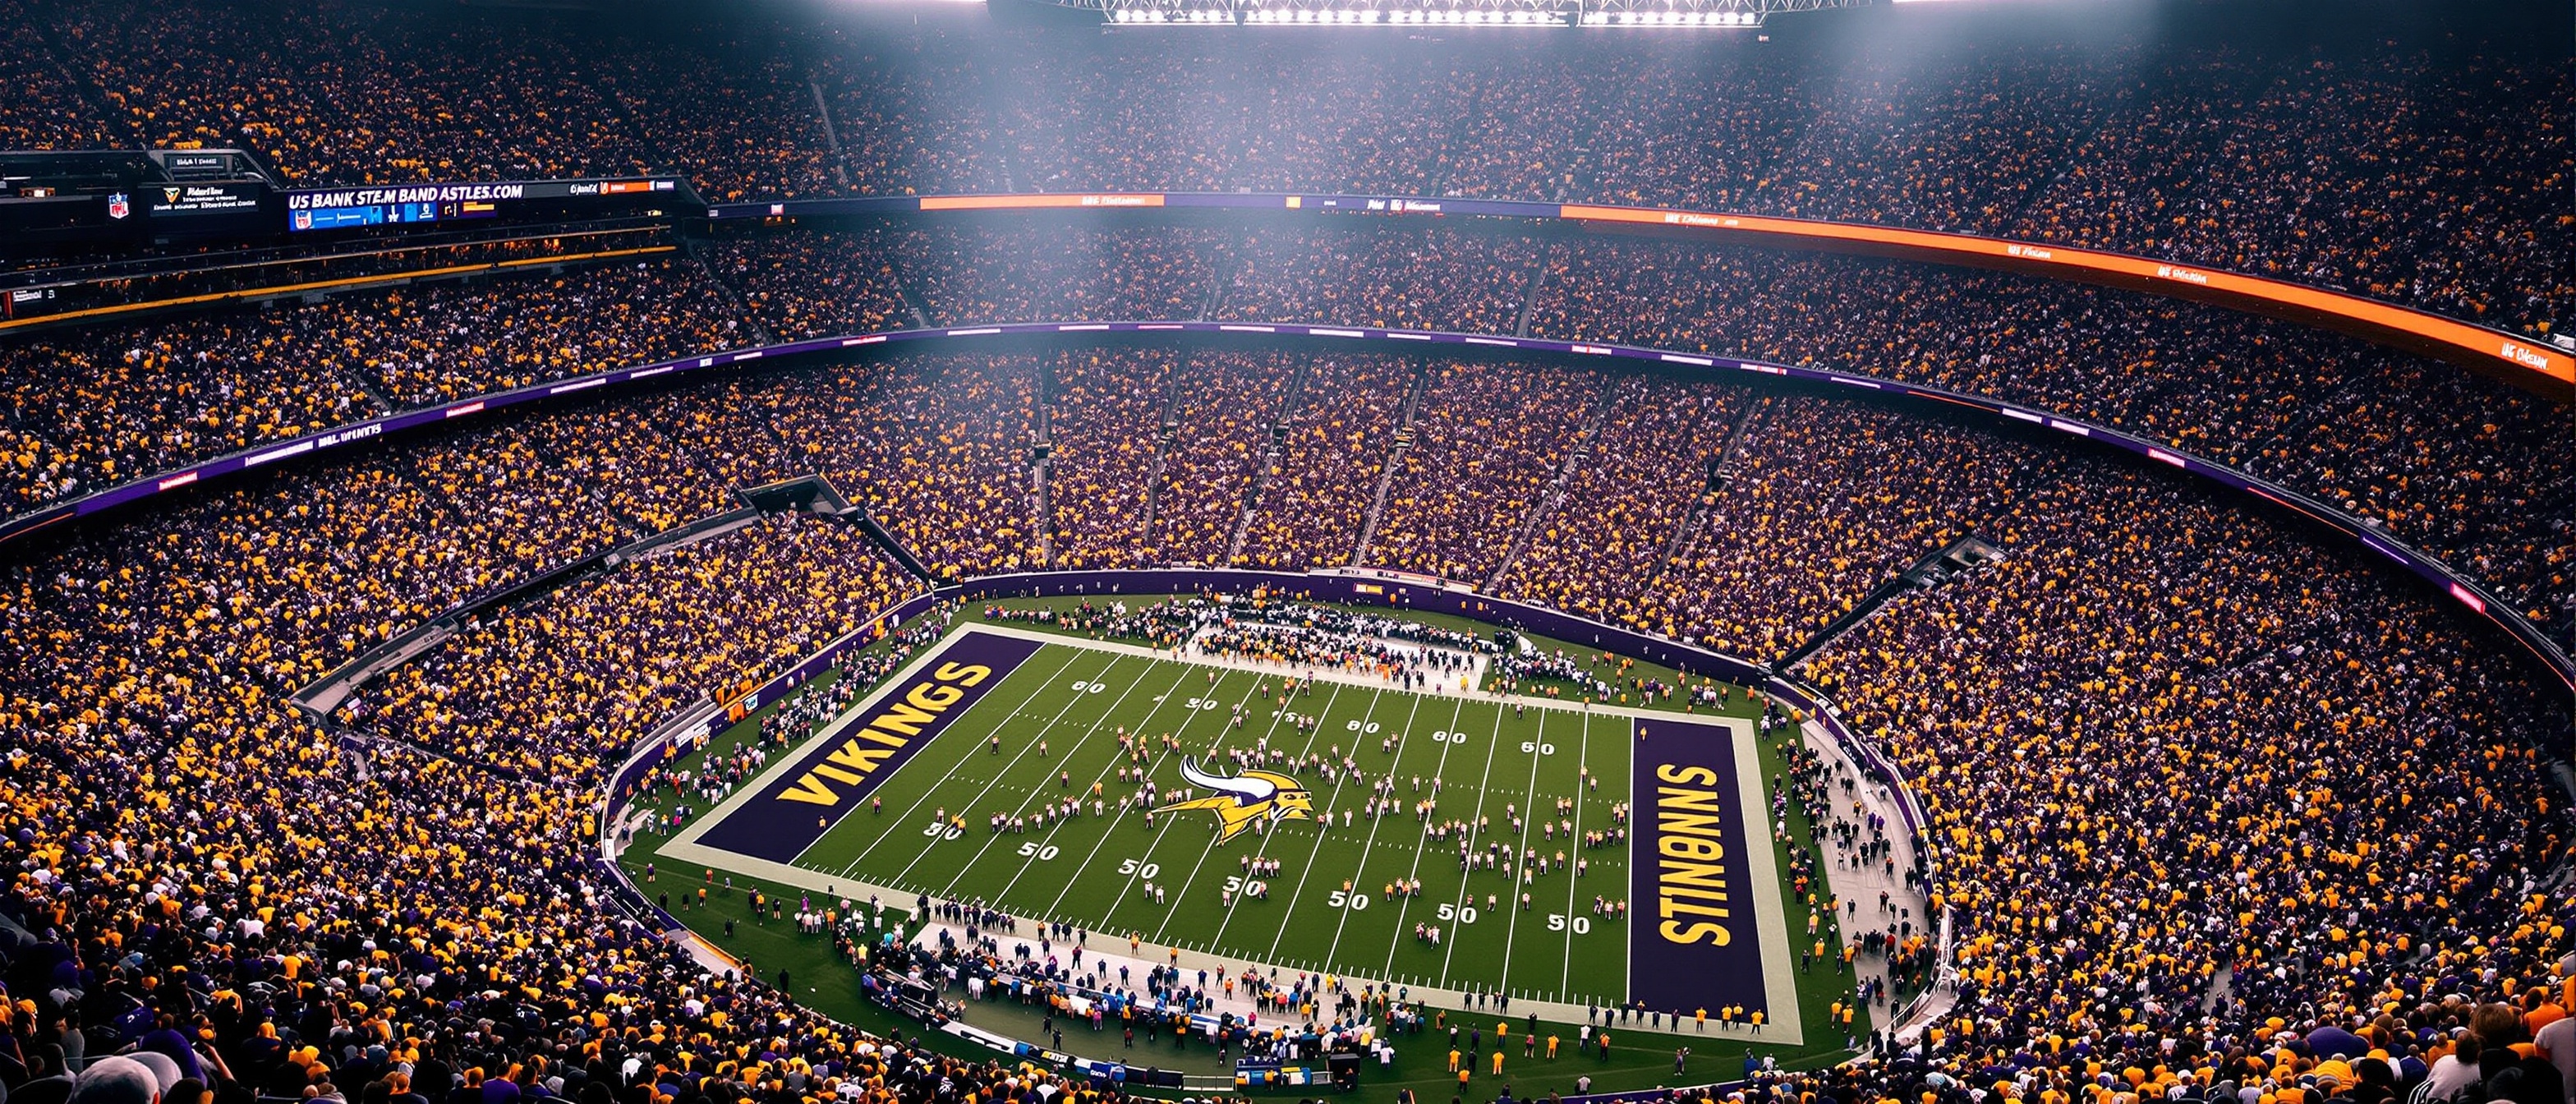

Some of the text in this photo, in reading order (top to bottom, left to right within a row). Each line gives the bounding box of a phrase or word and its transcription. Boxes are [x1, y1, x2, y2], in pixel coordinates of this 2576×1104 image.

[289, 196, 310, 209] US
[312, 192, 355, 209] BANK
[398, 187, 438, 203] BAND
[775, 661, 991, 807] VIKINGS
[1017, 841, 1060, 861] 50
[1117, 858, 1160, 879] 50
[1327, 890, 1370, 910] 50
[1437, 903, 1477, 924] 50
